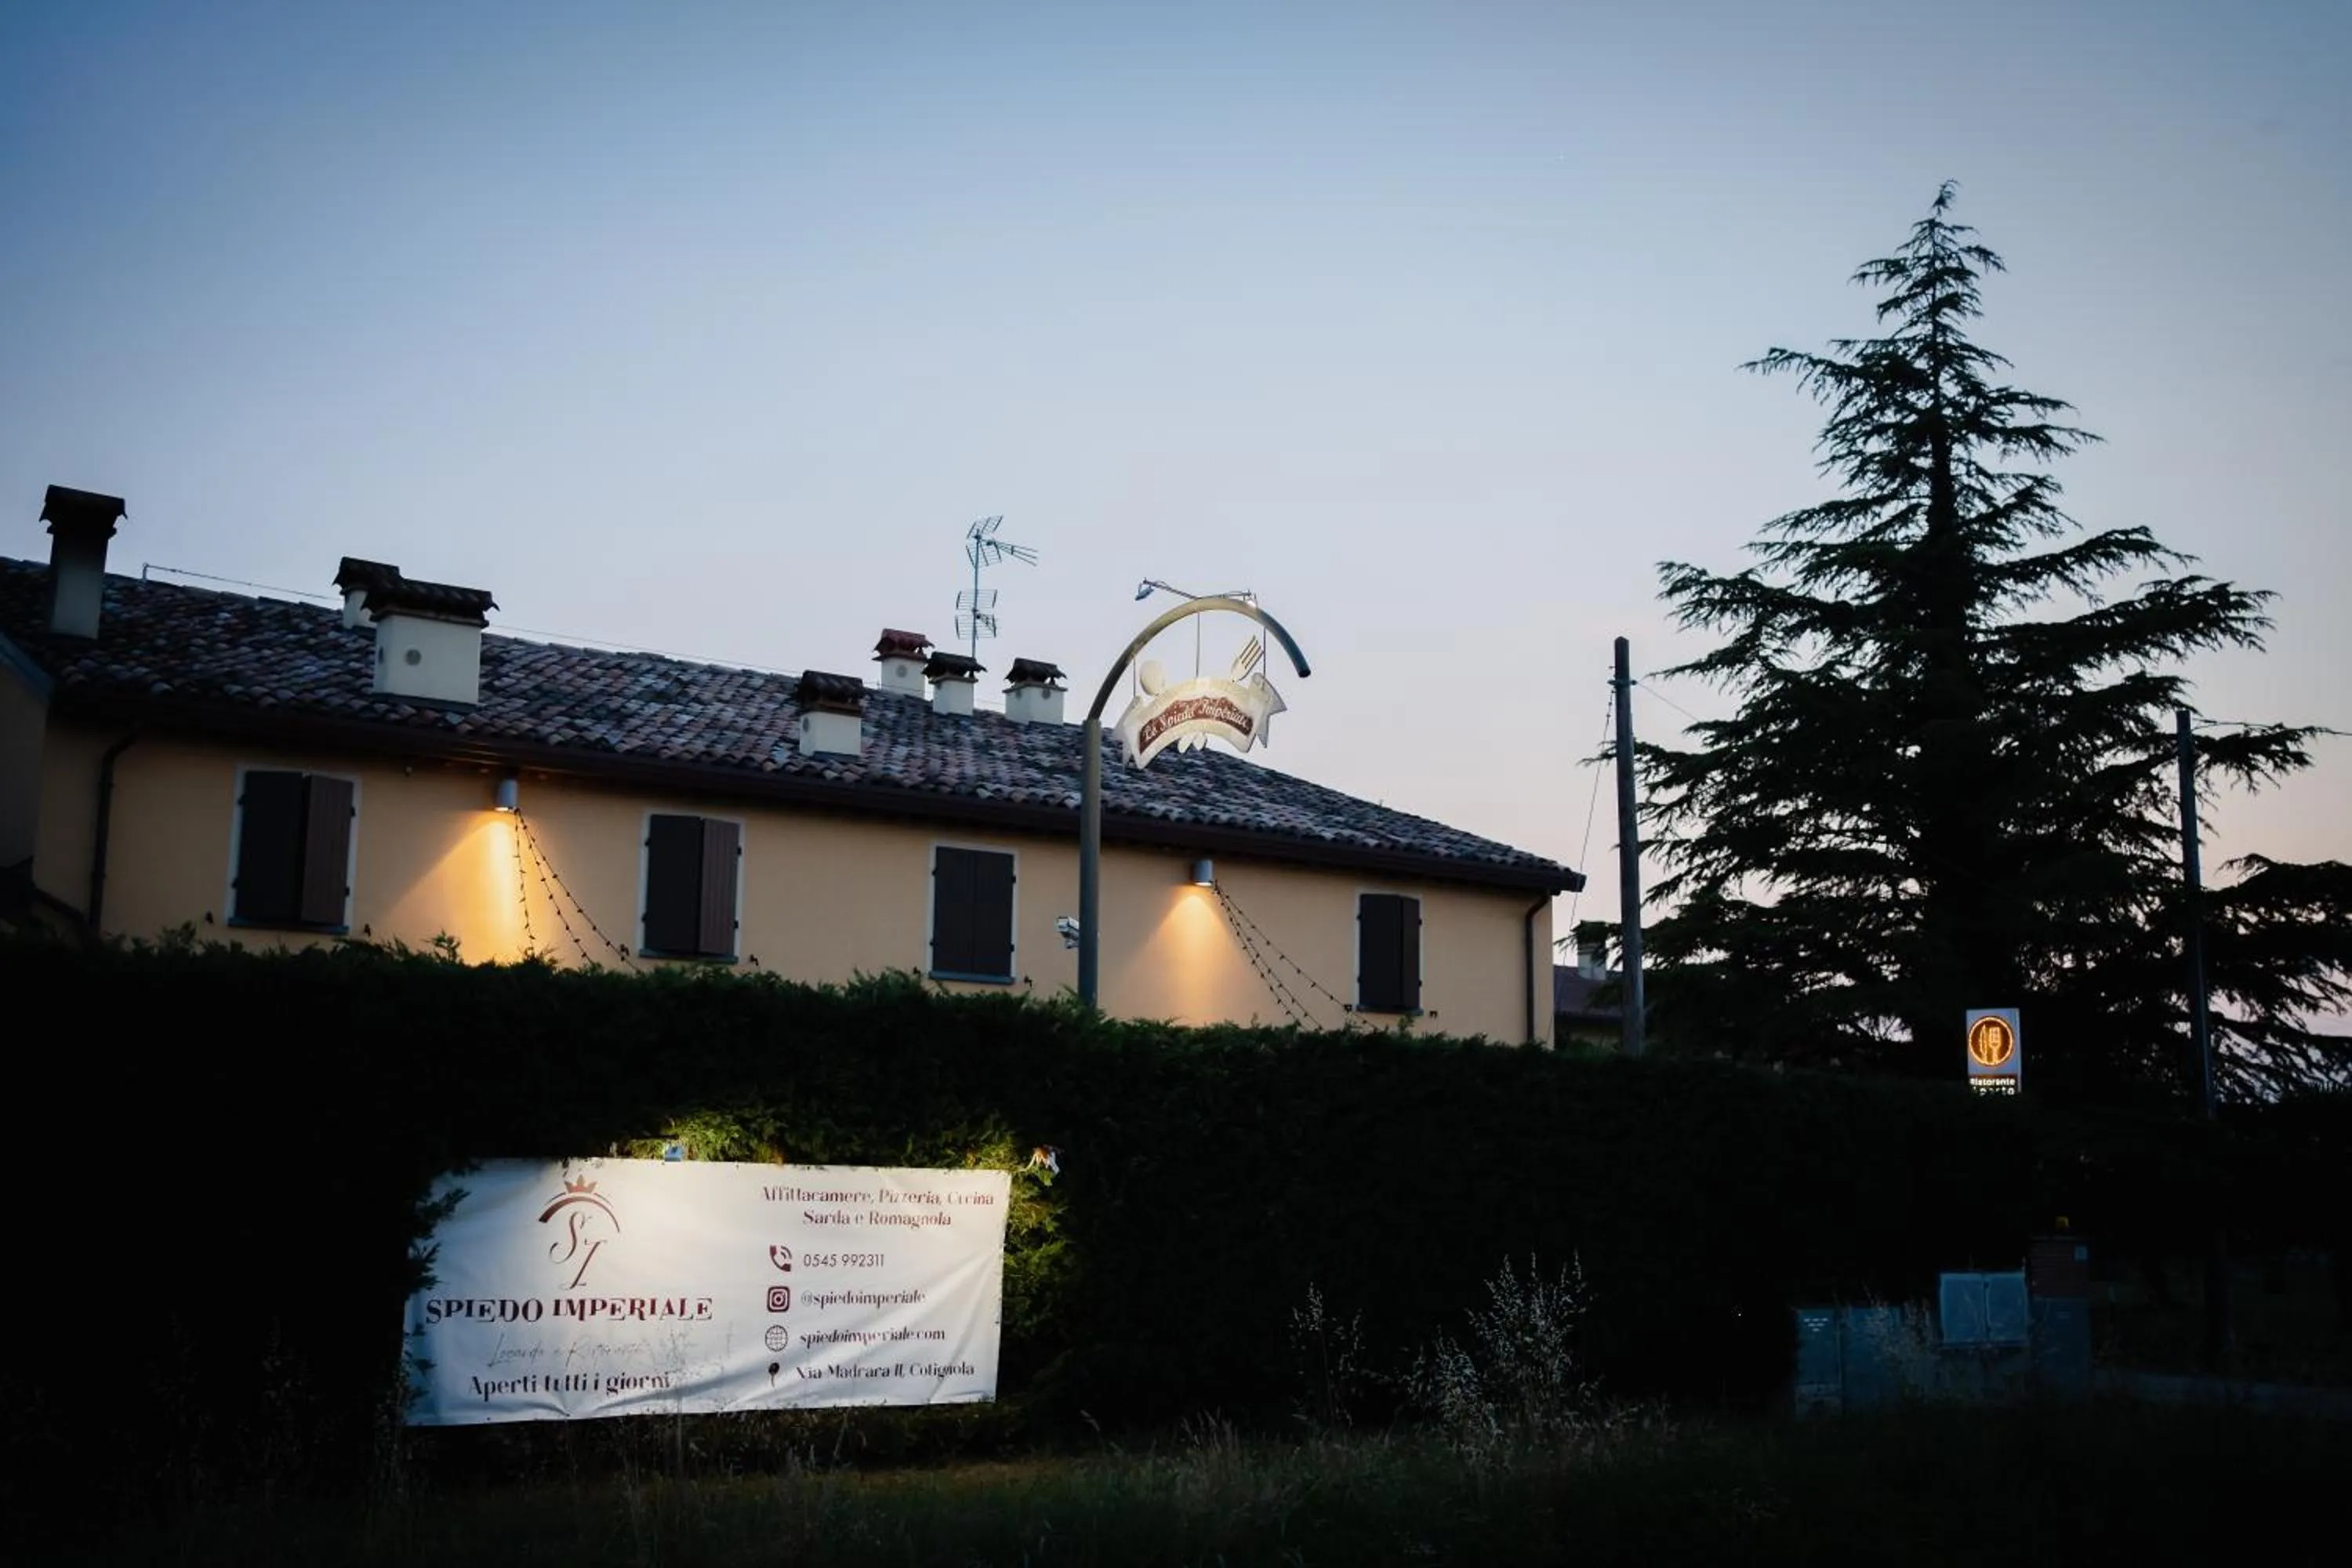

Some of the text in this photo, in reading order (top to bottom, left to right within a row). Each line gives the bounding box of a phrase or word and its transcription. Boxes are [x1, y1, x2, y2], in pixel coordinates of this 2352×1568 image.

[803, 1210, 952, 1229] Sarda e Romagnola
[804, 1254, 884, 1268] 0545 992311
[801, 1290, 926, 1310] @spiedoimperiale
[426, 1298, 713, 1323] SPIEDO IMPERIALE
[796, 1367, 822, 1379] Via
[471, 1371, 671, 1402] Aperti tutti i giorni
